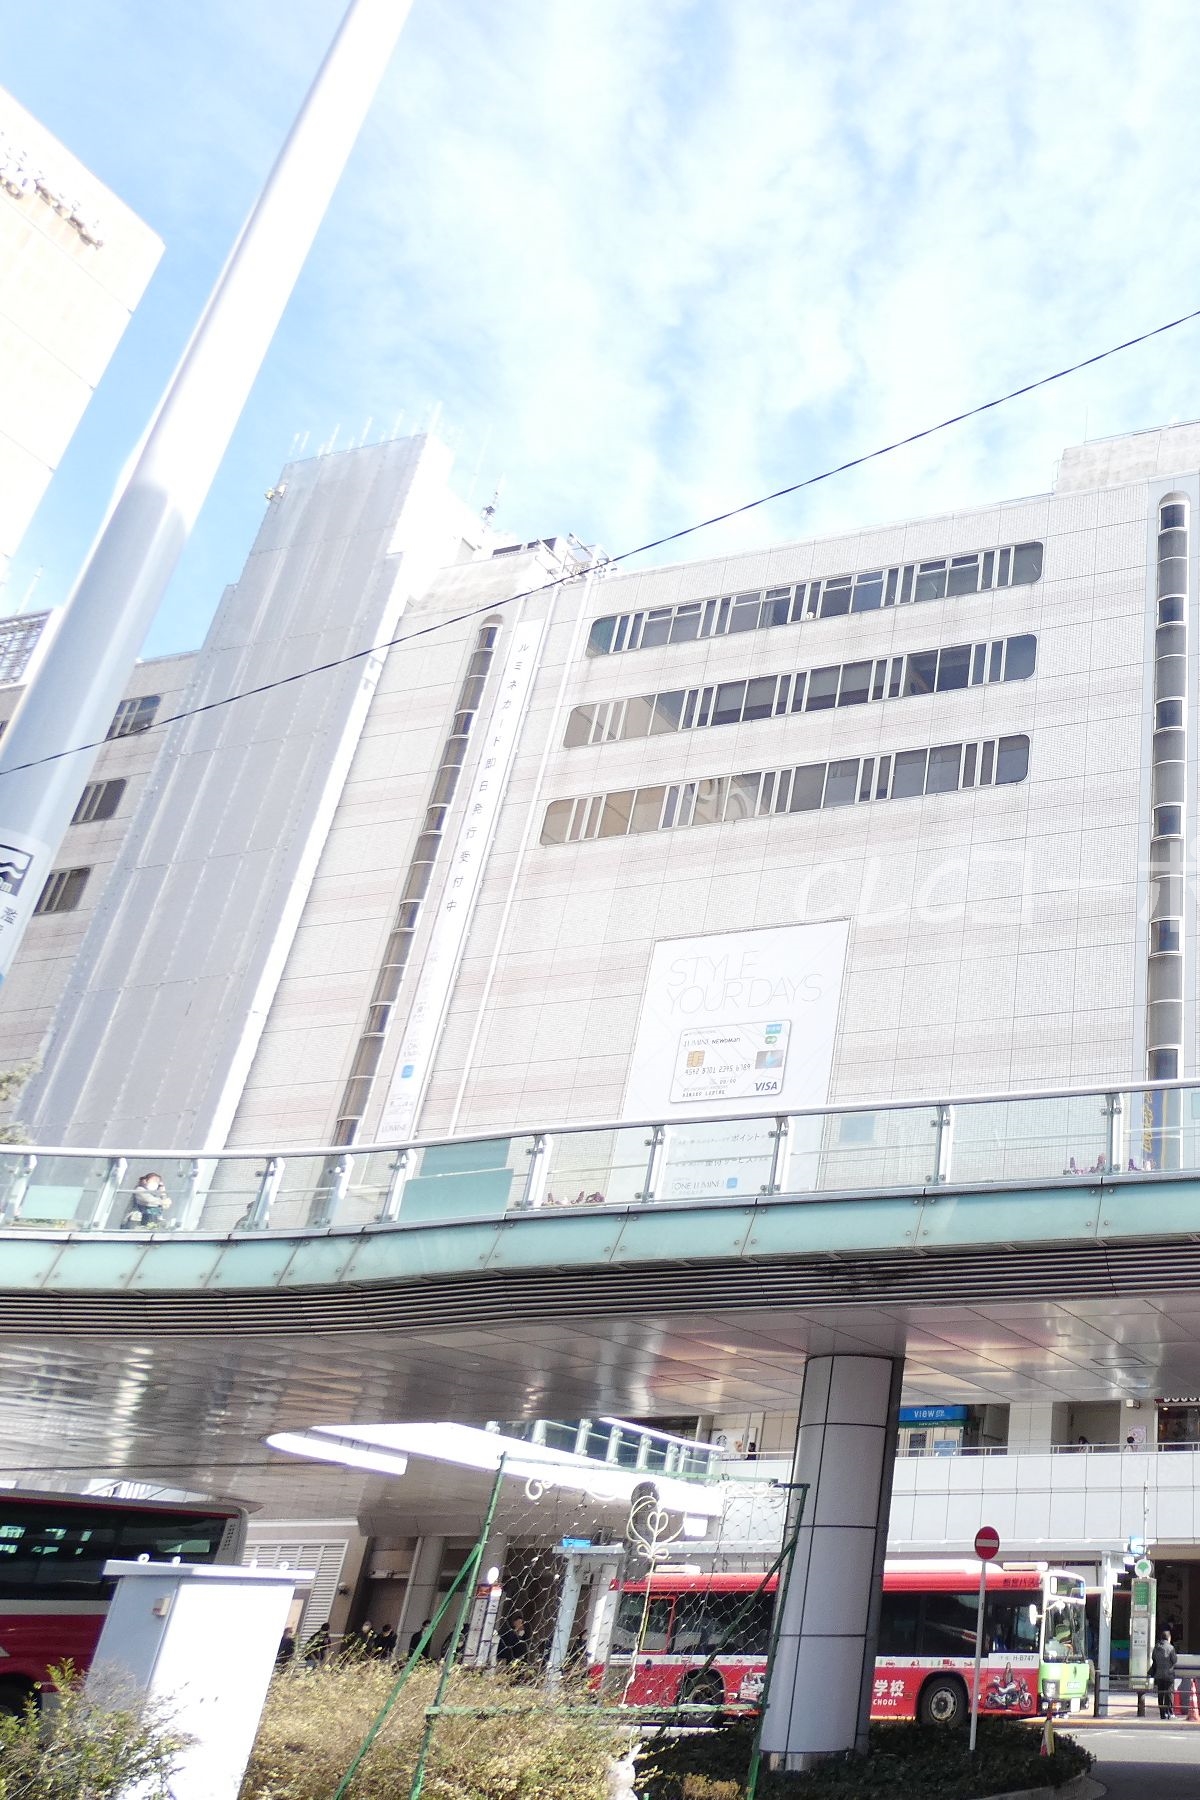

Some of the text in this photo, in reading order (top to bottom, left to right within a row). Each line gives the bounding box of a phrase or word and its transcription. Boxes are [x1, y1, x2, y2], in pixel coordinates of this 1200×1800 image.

[446, 643, 529, 913] ルミネカード即日発行受付中
[667, 949, 760, 987] STYLE
[755, 1081, 778, 1092] VISA
[873, 1679, 905, 1697] 学校
[872, 1698, 897, 1706] CHOOL
